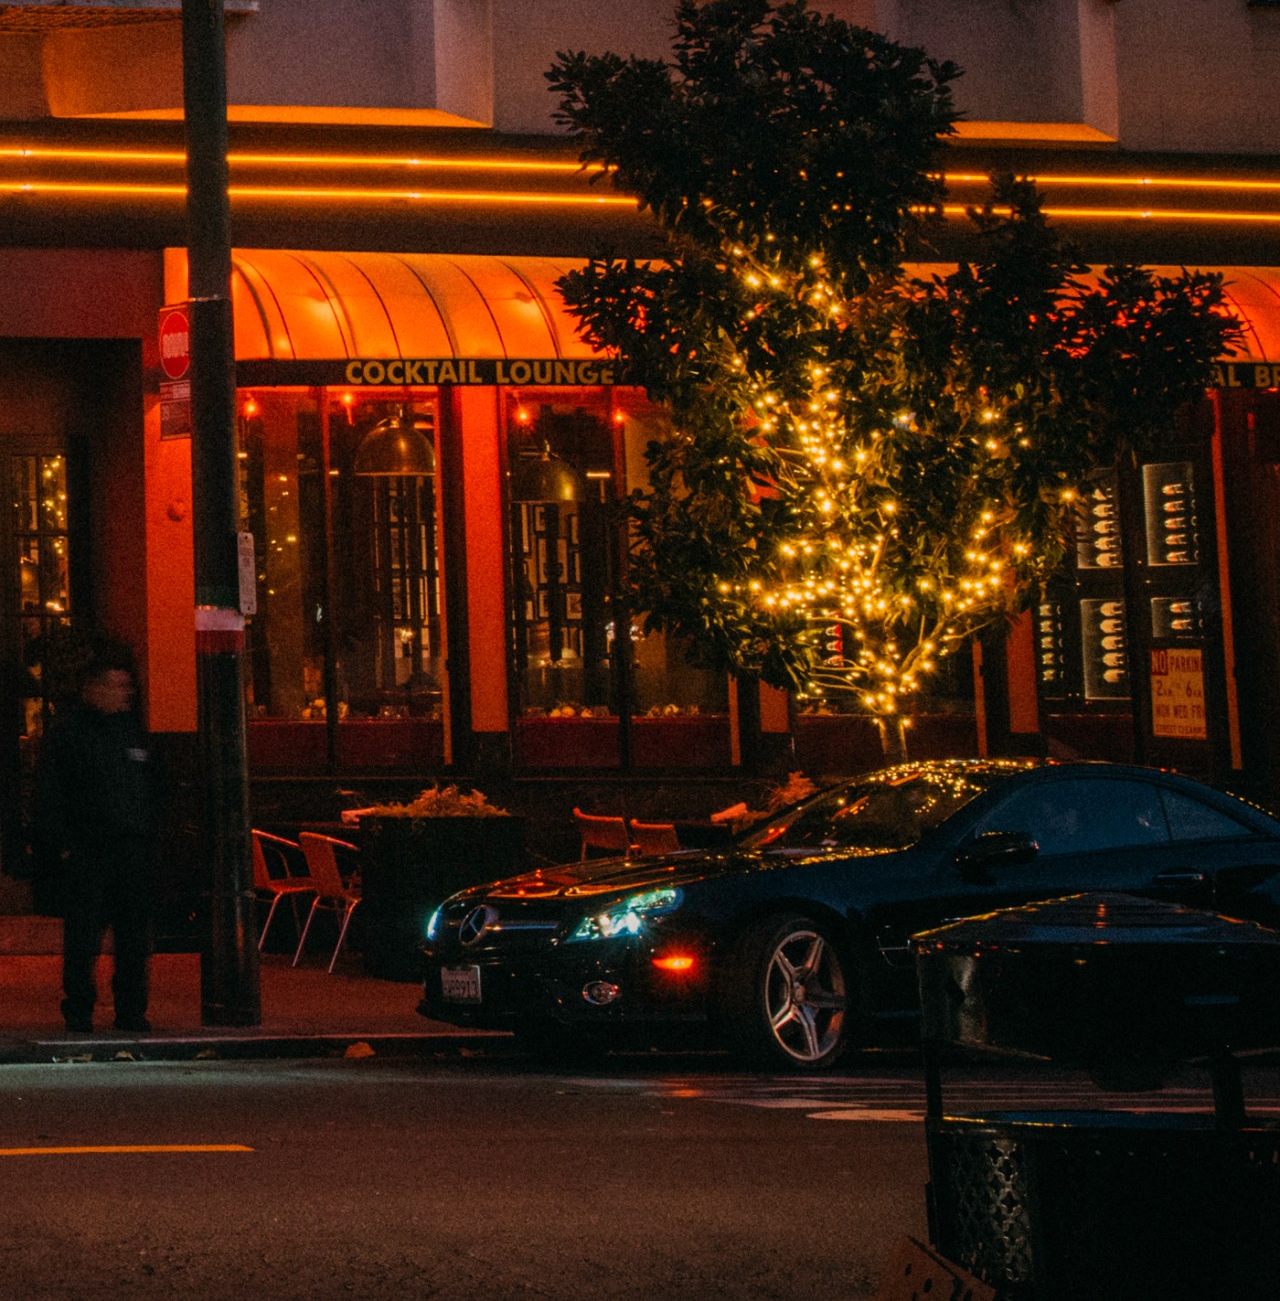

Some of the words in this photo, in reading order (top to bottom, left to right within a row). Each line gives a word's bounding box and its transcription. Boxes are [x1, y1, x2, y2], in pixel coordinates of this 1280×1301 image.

[345, 361, 483, 384] COCKTAIL
[496, 361, 615, 385] LOUNGE
[1152, 650, 1168, 675] NO
[1170, 656, 1202, 674] PARKIN
